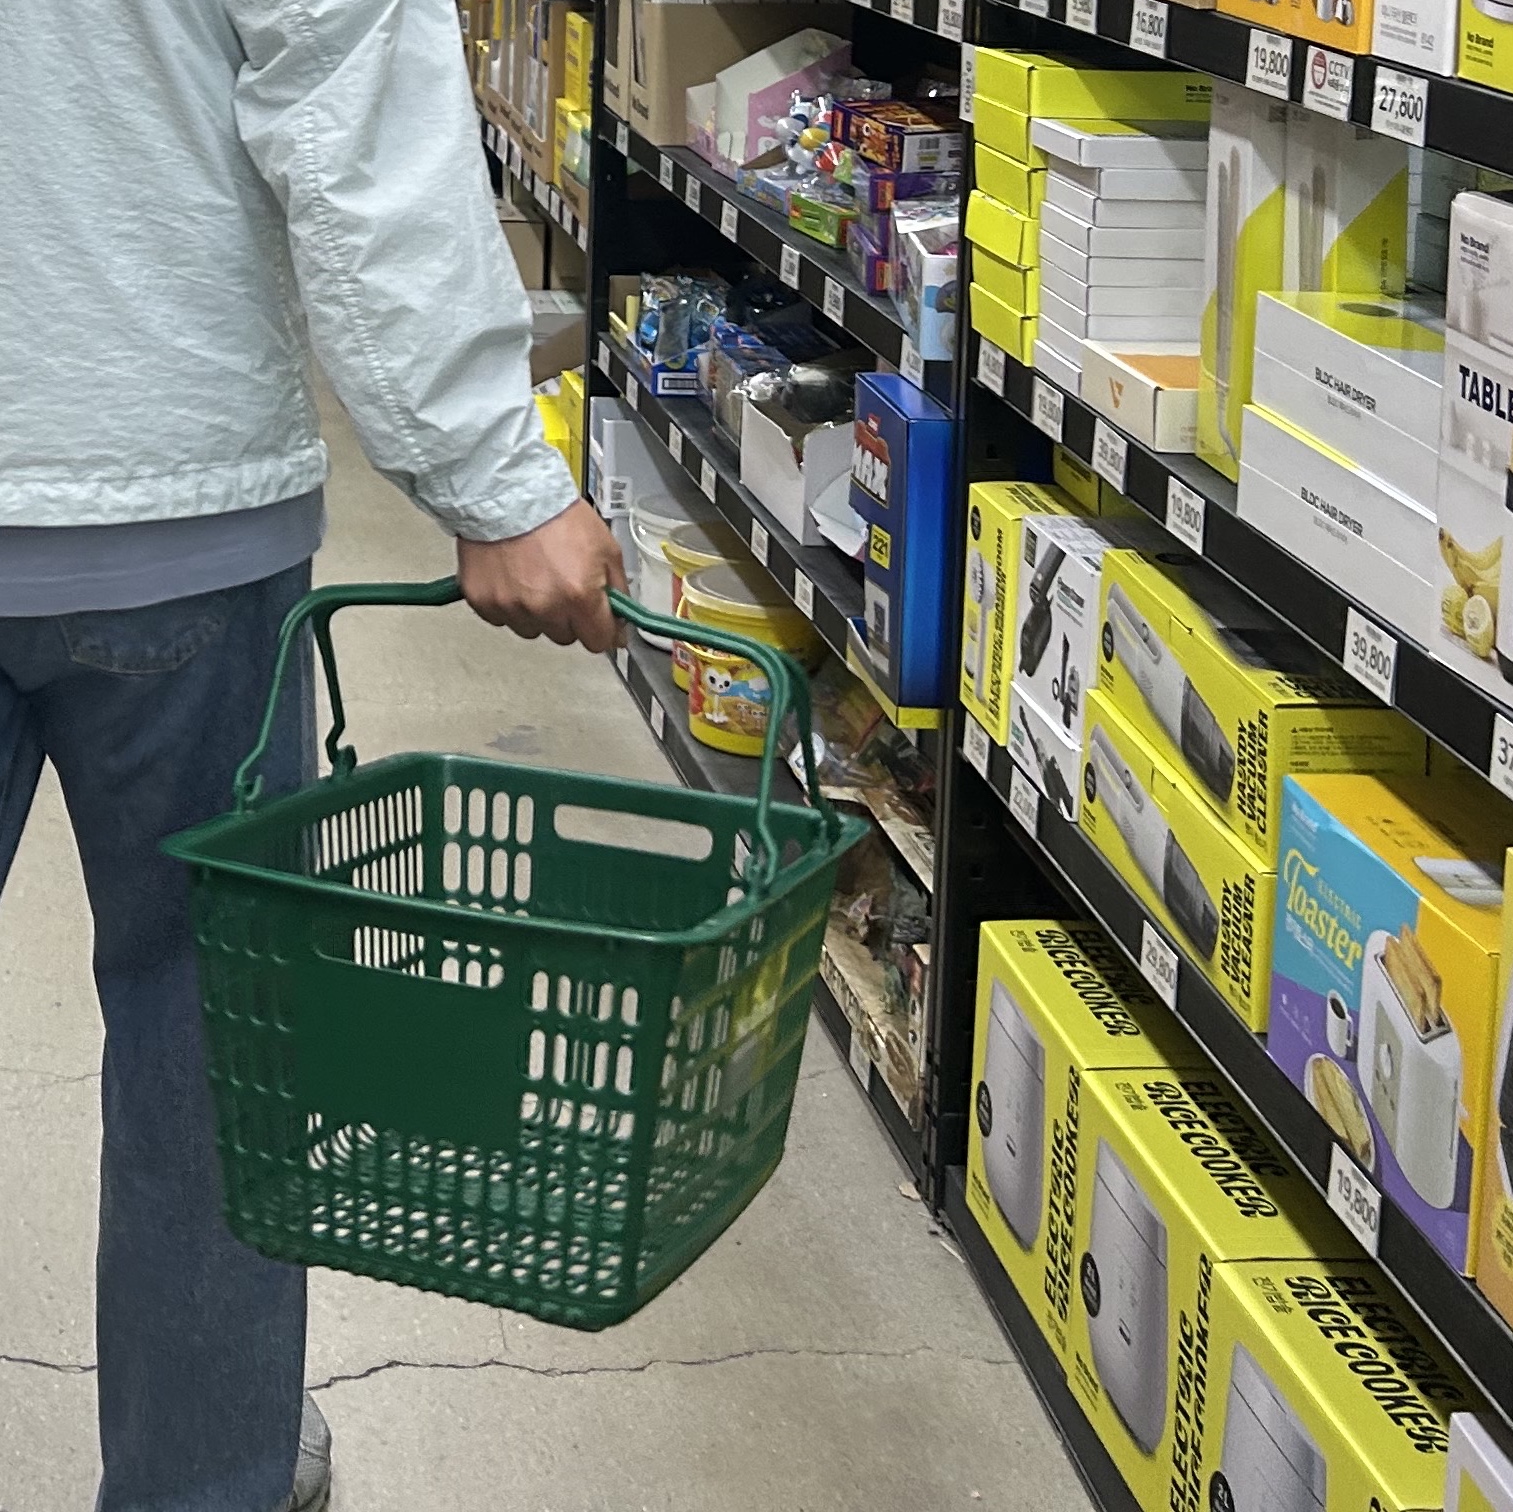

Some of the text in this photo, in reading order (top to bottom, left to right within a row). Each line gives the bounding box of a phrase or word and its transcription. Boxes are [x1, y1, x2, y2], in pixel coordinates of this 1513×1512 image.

[1135, 9, 1165, 39] 16,800
[1253, 45, 1289, 78] 19,800
[1328, 59, 1350, 81] CCTV
[1378, 84, 1424, 124] 27,800
[1333, 377, 1352, 402] HAIR
[1350, 384, 1377, 414] DRYER
[1170, 492, 1202, 535] 19,800
[1320, 498, 1339, 522] HAIR
[1336, 507, 1364, 538] DRYER
[1351, 630, 1393, 681] 39,800
[1236, 717, 1248, 817] HANDY
[1243, 719, 1259, 822] VACUUM
[1255, 708, 1270, 836] CLEANER
[1220, 877, 1233, 978] HANDY
[1228, 881, 1244, 984] VACUUM
[1240, 872, 1257, 999] CLEANER
[1282, 848, 1364, 972] Toaster
[1035, 928, 1141, 1038] RICE COOKER
[1144, 939, 1176, 990] 29,800
[1062, 1063, 1082, 1229] COOKER
[1142, 1079, 1279, 1220] RICE COOKER
[1044, 1117, 1065, 1309] ELECTRIC
[1337, 1167, 1377, 1233] 19,800
[1285, 1274, 1450, 1456] RICE COOKER
